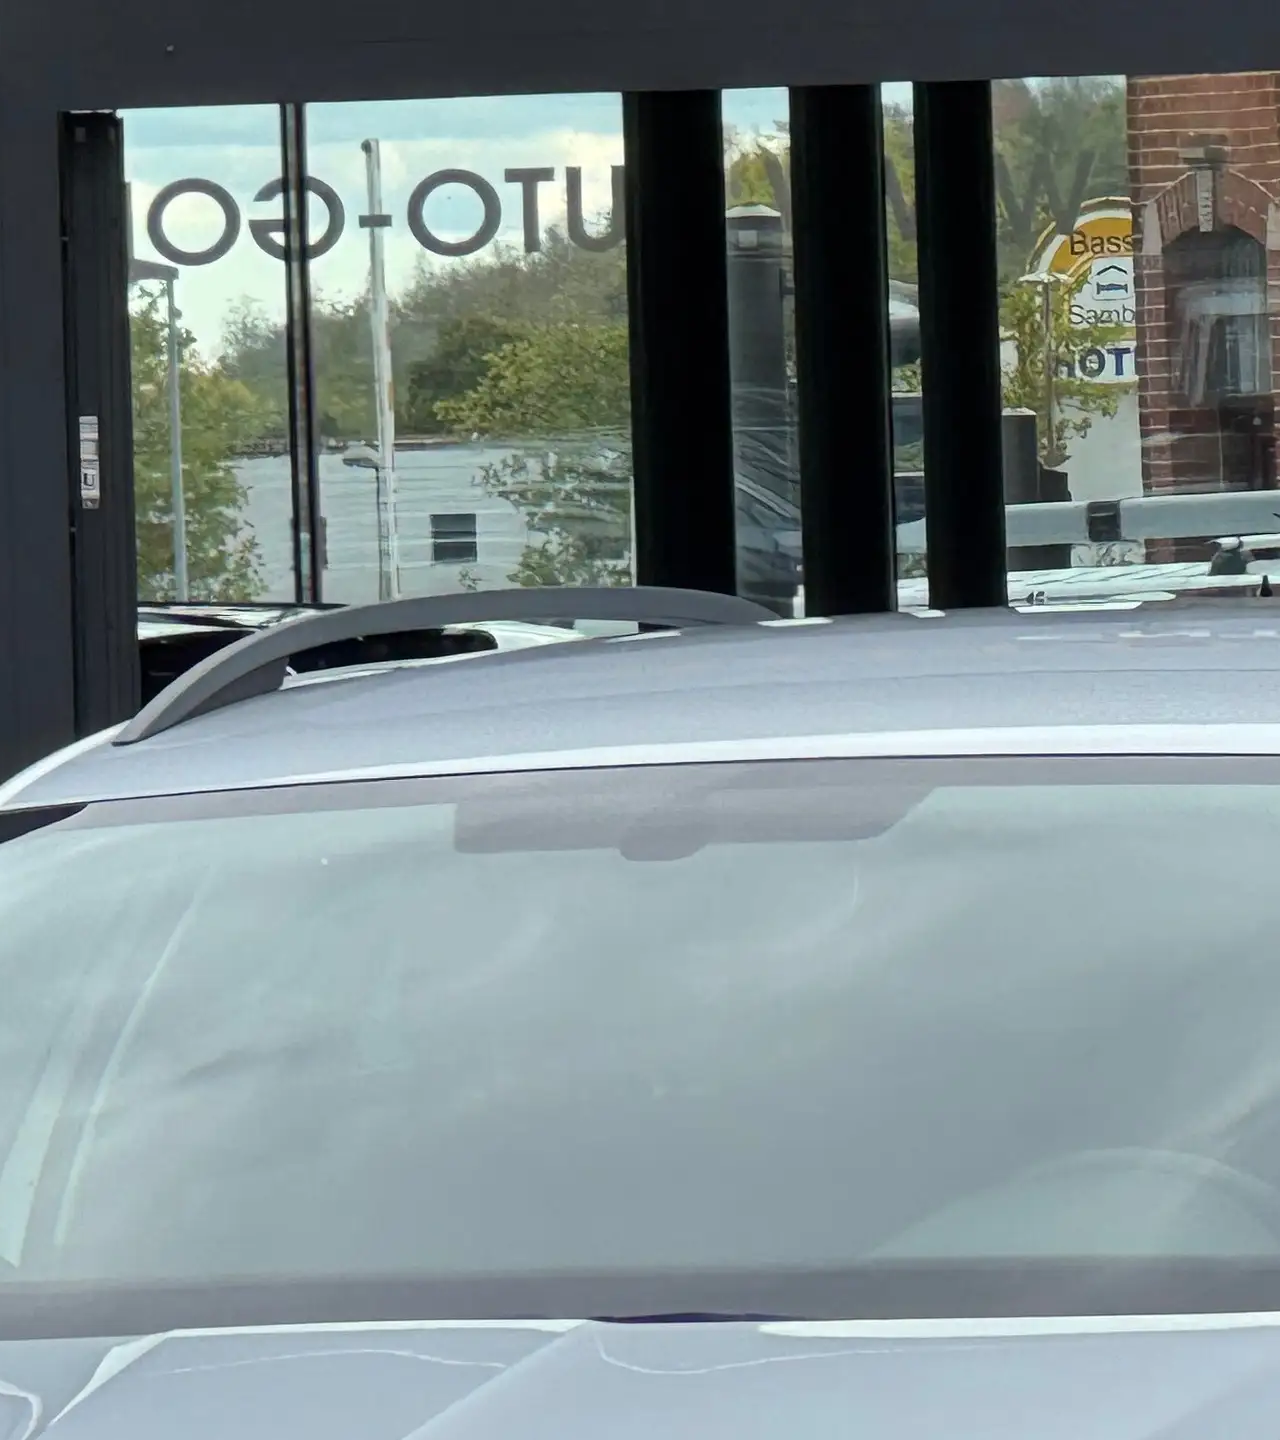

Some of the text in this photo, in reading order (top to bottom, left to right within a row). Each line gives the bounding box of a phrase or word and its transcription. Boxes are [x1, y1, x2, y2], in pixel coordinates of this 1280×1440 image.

[1070, 231, 1134, 256] Bass
[1070, 304, 1136, 325] Samb
[1055, 347, 1132, 378] HOT
